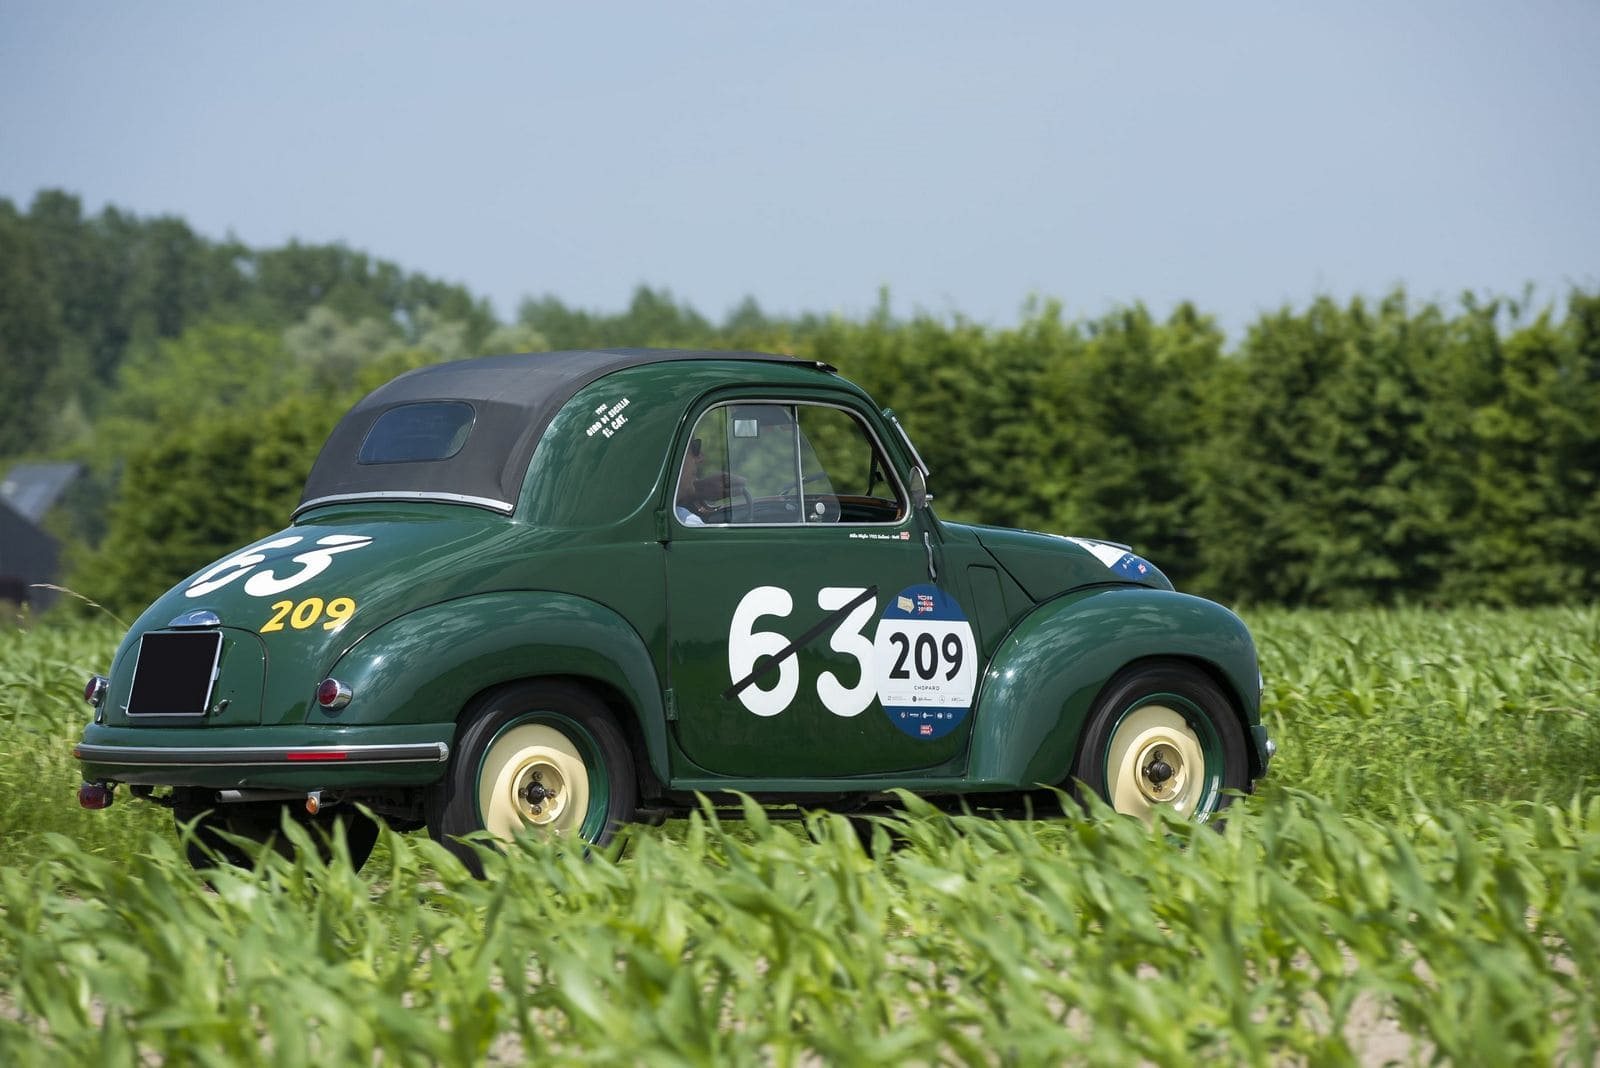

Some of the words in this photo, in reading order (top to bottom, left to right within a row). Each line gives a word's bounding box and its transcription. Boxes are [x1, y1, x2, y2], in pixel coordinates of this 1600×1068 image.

[586, 421, 602, 436] GIRO
[600, 414, 610, 424] DI
[608, 397, 630, 418] SICILIA
[611, 414, 628, 430] CAT.
[185, 534, 373, 598] 63
[259, 597, 356, 633] 209
[729, 586, 877, 717] 63
[889, 632, 963, 682] 209
